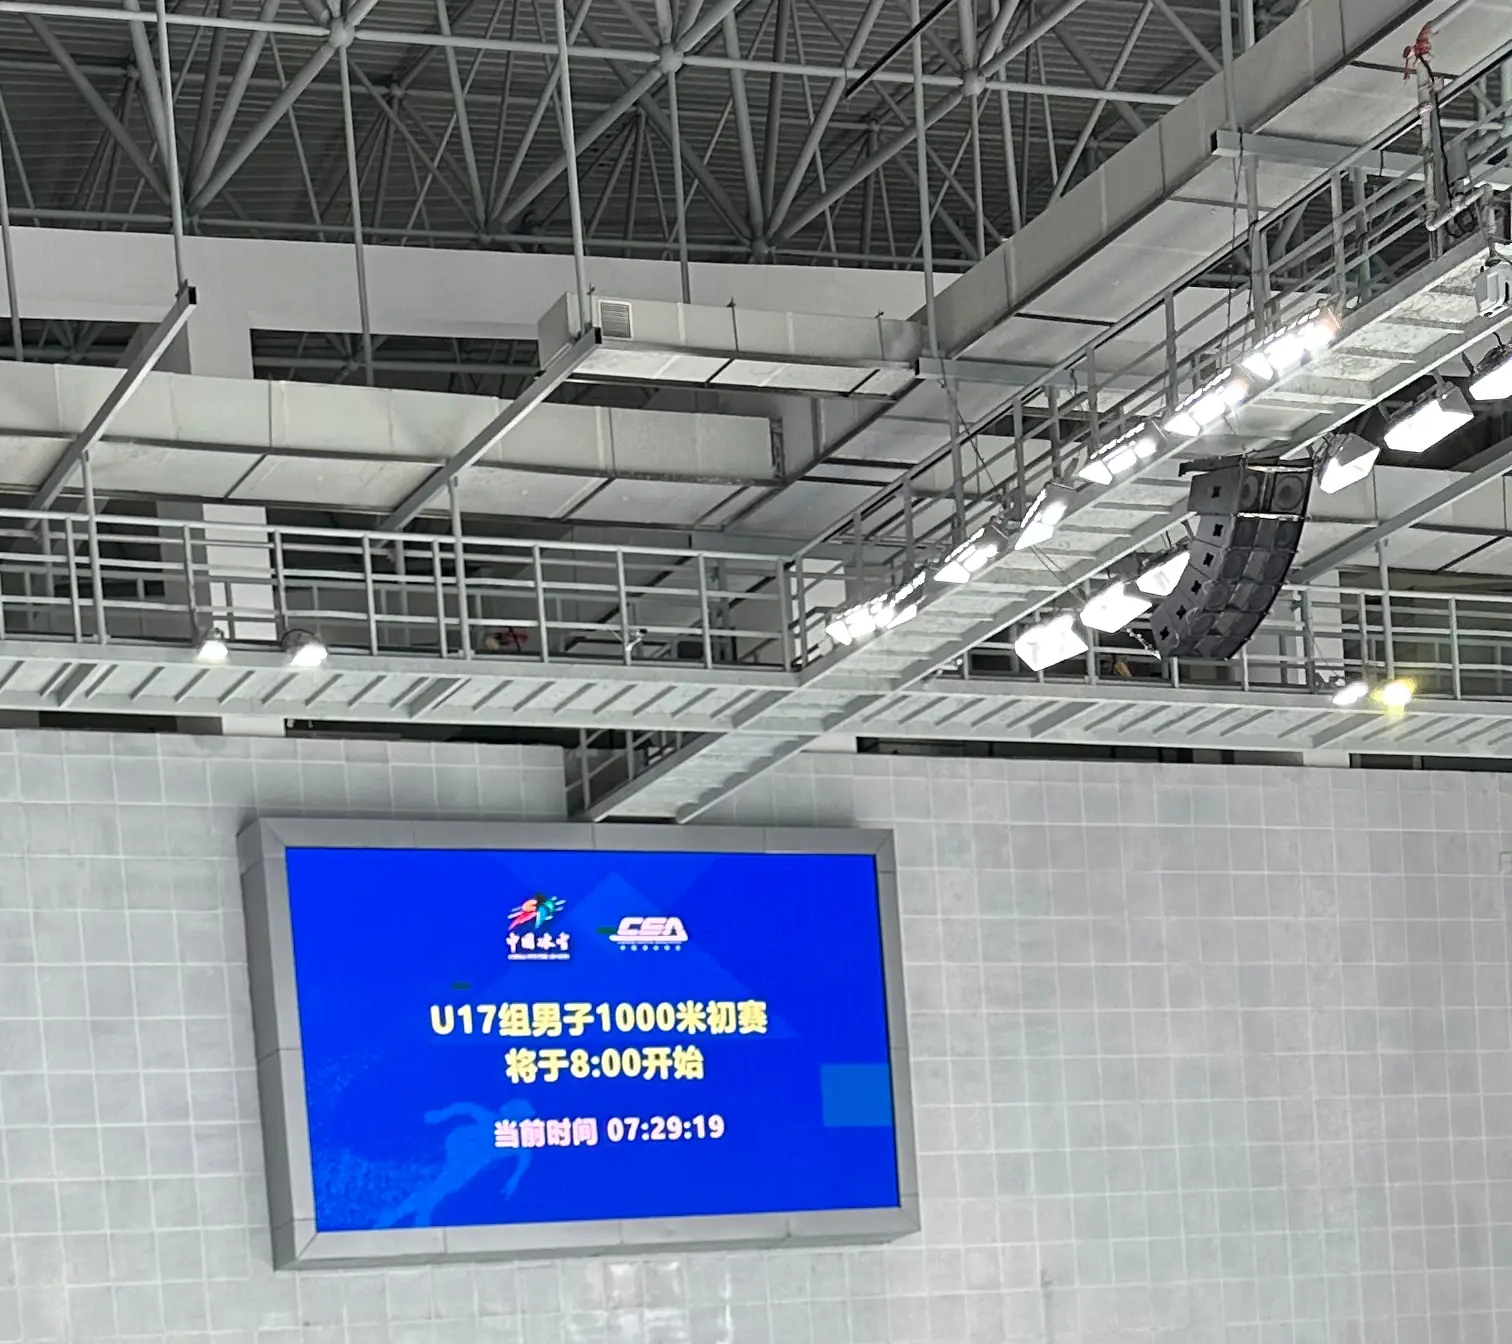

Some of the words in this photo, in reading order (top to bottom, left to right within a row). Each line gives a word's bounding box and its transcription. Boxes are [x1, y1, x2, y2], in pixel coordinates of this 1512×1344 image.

[430, 1000, 767, 1036] U17组男子1000米初赛
[505, 1048, 705, 1083] 将于8:00开始
[493, 1118, 598, 1148] 当前时间
[606, 1115, 725, 1143] 07:29:19
